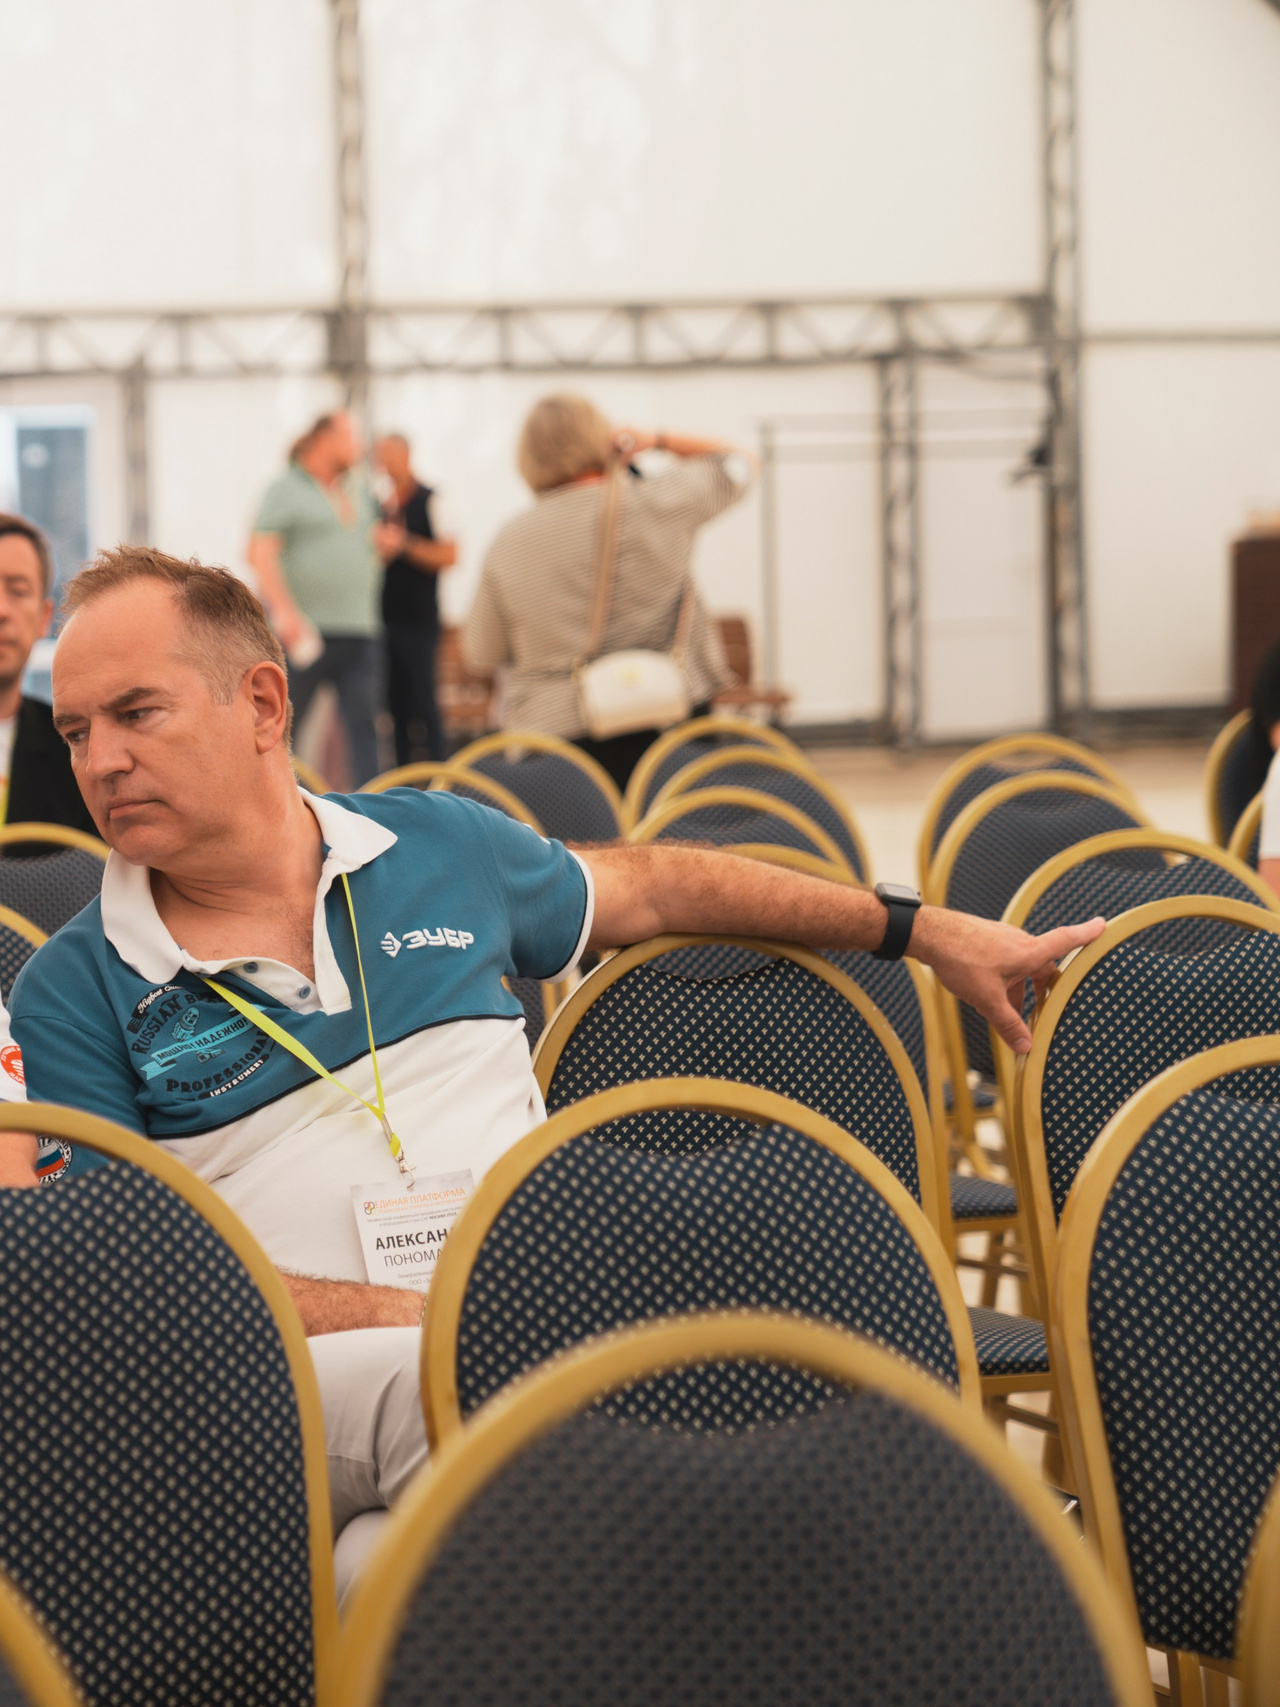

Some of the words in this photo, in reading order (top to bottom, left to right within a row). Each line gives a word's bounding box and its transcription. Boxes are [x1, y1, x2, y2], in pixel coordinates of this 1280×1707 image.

[402, 927, 474, 950] ЗУБР
[131, 993, 183, 1054] RUSSIAN
[197, 1017, 249, 1048] НАДЕЖНО!
[209, 1058, 265, 1097] INSTRUMENT
[410, 1187, 466, 1205] ПЛАТФОРМА
[376, 1228, 448, 1251] АЛЕКСАН
[384, 1248, 442, 1267] ПОНОМА
